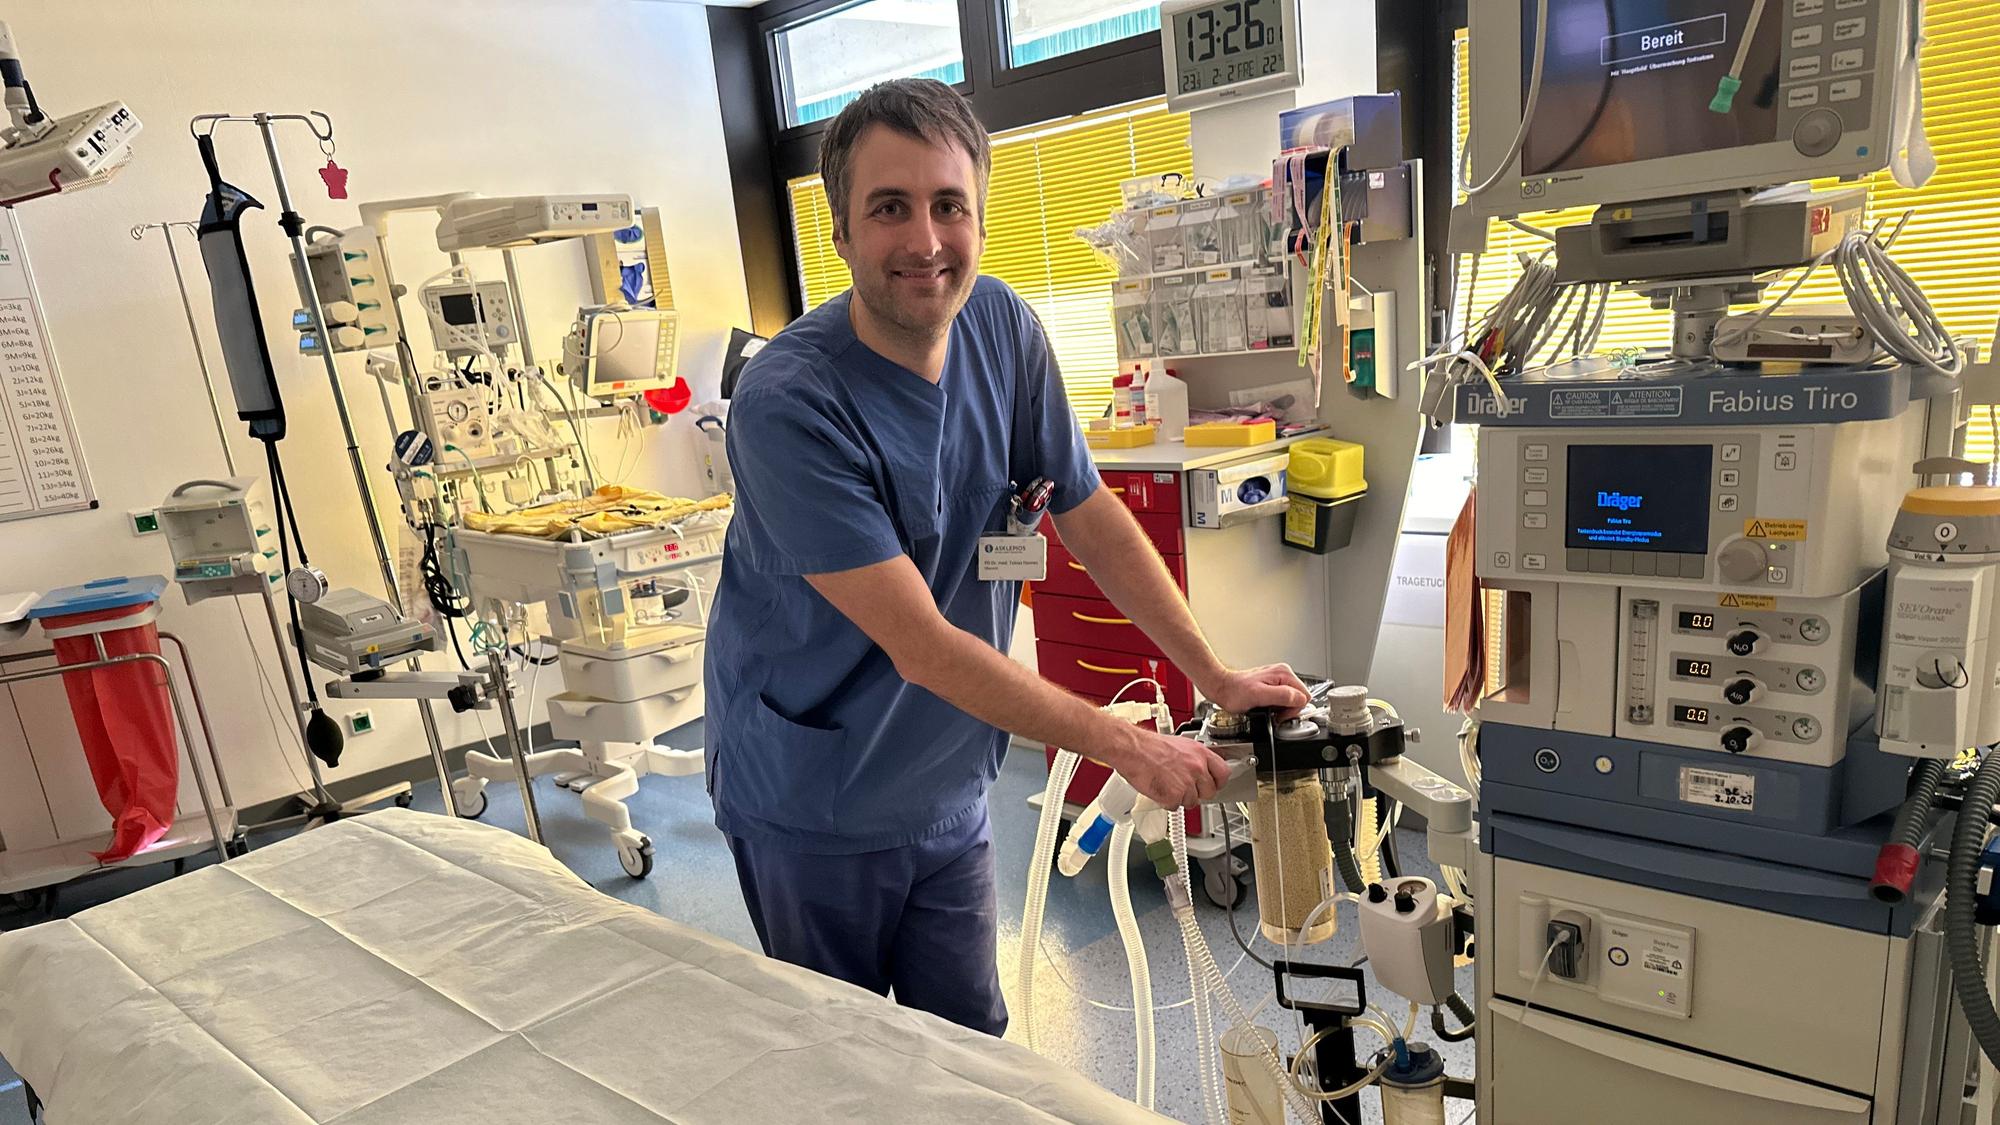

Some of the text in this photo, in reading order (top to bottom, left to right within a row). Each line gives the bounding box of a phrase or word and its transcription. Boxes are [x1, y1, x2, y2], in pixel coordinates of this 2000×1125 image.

[1187, 0, 1264, 62] 13:26
[1641, 30, 1684, 51] Bereit
[9, 364, 40, 372] 1J=10kg
[12, 376, 44, 384] 2J=12kg
[16, 387, 47, 396] 3J=14kg
[1629, 391, 1671, 399] ATTENTION
[1468, 392, 1528, 418] Dräer
[1708, 386, 1858, 413] Fabius Tiro
[22, 411, 54, 420] 6J=20kg
[30, 434, 61, 444] 8J=24kg
[1221, 488, 1233, 503] M
[1597, 491, 1642, 511] Dräger
[1197, 512, 1206, 525] M
[1765, 522, 1787, 530] Betrieb
[1692, 614, 1713, 628] 0.0
[1689, 662, 1710, 675] 0.0
[1730, 691, 1744, 702] AIR
[1686, 708, 1707, 722] 0.0
